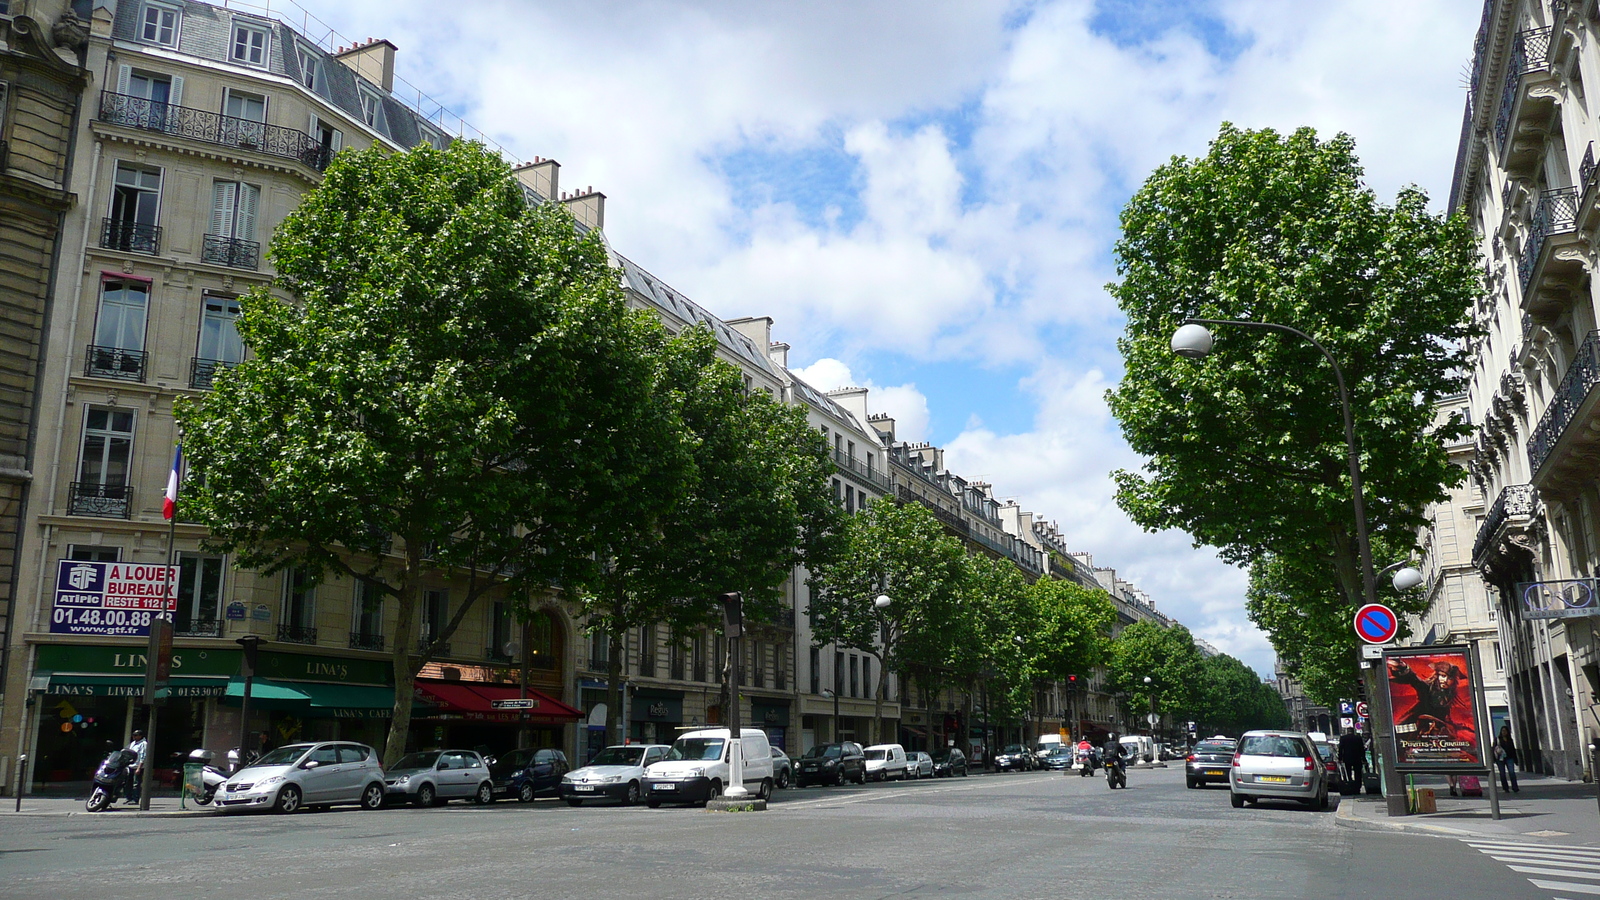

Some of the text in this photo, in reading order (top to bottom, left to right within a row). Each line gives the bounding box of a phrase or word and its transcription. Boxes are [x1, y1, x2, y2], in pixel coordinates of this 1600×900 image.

[110, 566, 176, 581] A LOUER
[108, 582, 174, 596] BUREAUX
[106, 597, 140, 607] RESTE
[1528, 608, 1595, 618] AUDIOVISION
[70, 625, 139, 634] www.gtf.fr
[113, 653, 182, 669] LINS
[306, 662, 348, 677] LINA'S
[45, 684, 94, 696] LINA'S
[178, 687, 188, 697] 01
[190, 687, 200, 697] 53
[201, 687, 211, 697] 30
[334, 708, 364, 718] LINA'S
[650, 704, 669, 716] Regus
